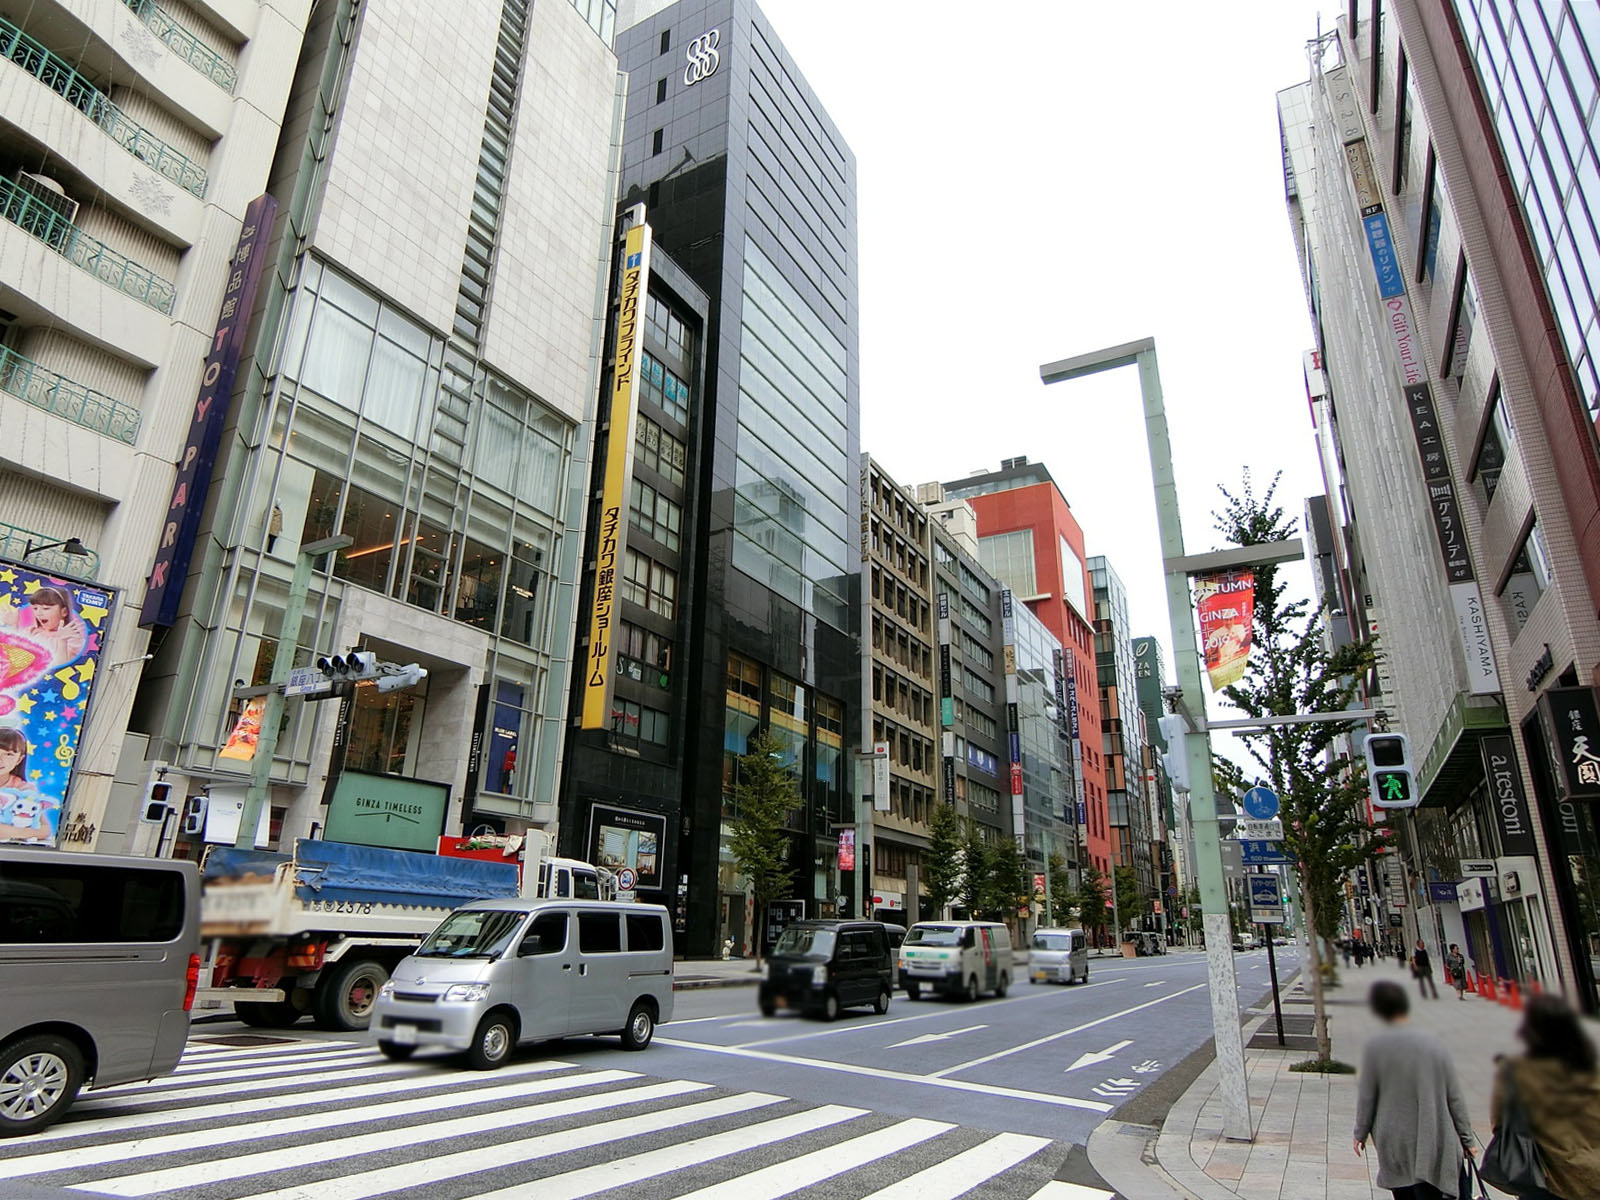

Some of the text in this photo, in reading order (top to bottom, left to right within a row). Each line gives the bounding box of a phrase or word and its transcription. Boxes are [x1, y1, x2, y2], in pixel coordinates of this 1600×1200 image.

[616, 270, 640, 392] タチカワブラインド
[1392, 312, 1421, 385] Gift Your Life
[149, 327, 230, 591] TOY PARK
[1439, 502, 1460, 559] グランデ
[588, 506, 620, 687] タチカワ銀座ショールーム
[1199, 607, 1240, 624] GINZA
[1467, 597, 1493, 677] KASHIYAMA
[356, 797, 423, 815] GINZA TIMELESS
[1490, 754, 1526, 836] a.testoni
